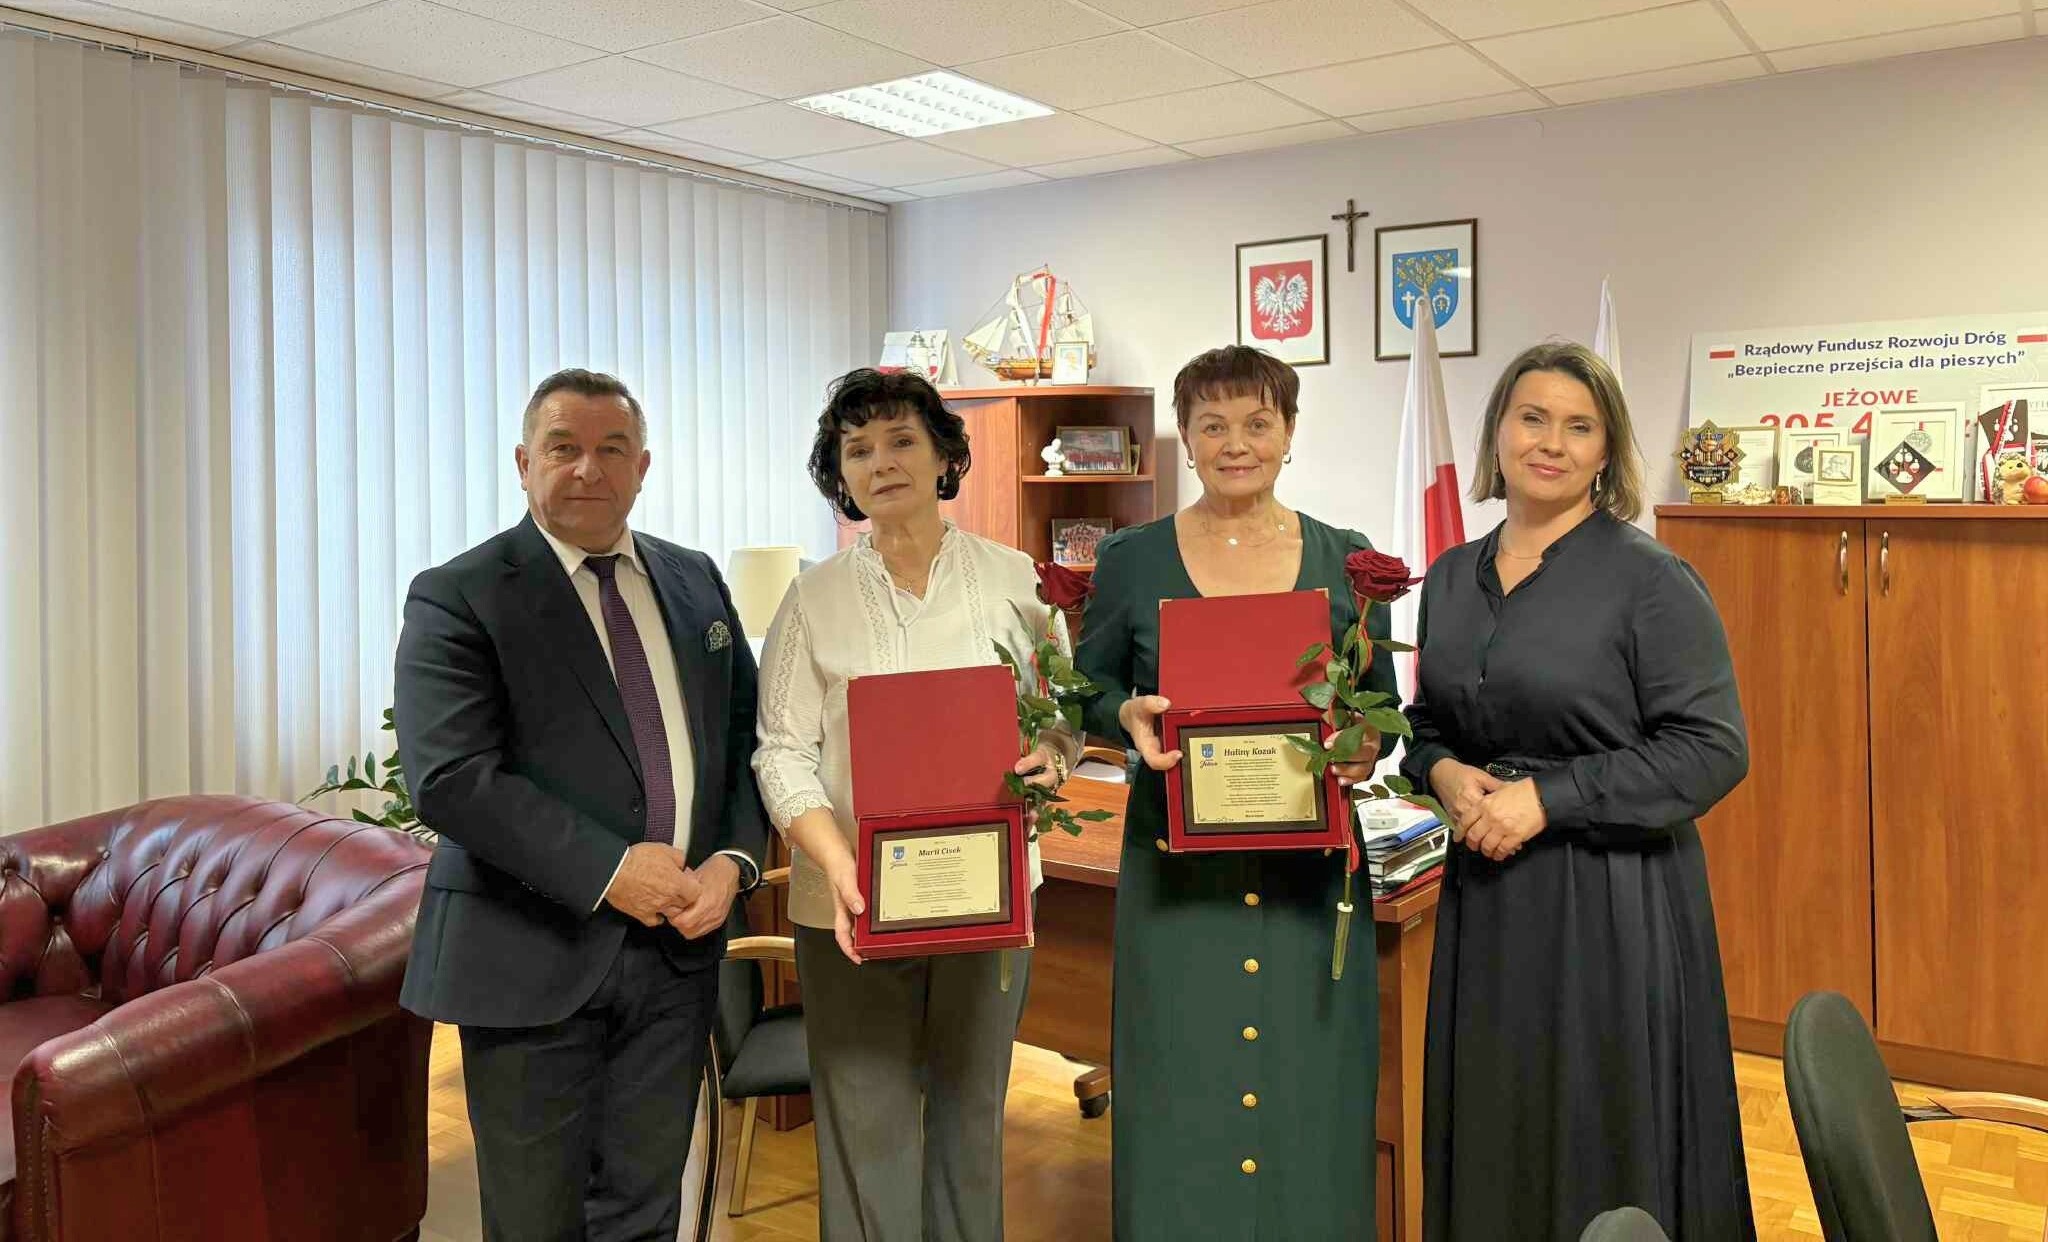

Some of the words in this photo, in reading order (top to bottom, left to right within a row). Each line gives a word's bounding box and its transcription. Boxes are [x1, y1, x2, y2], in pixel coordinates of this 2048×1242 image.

[1744, 342, 1813, 358] Rządowy
[1818, 337, 1883, 352] Fundusz
[1888, 332, 1959, 350] Rozwoju
[1964, 330, 2007, 347] Dróg
[1829, 355, 1904, 374] przejścia
[1909, 352, 1935, 369] dla
[1821, 387, 1919, 408] JEŻOWE
[1252, 746, 1277, 756] Kozak
